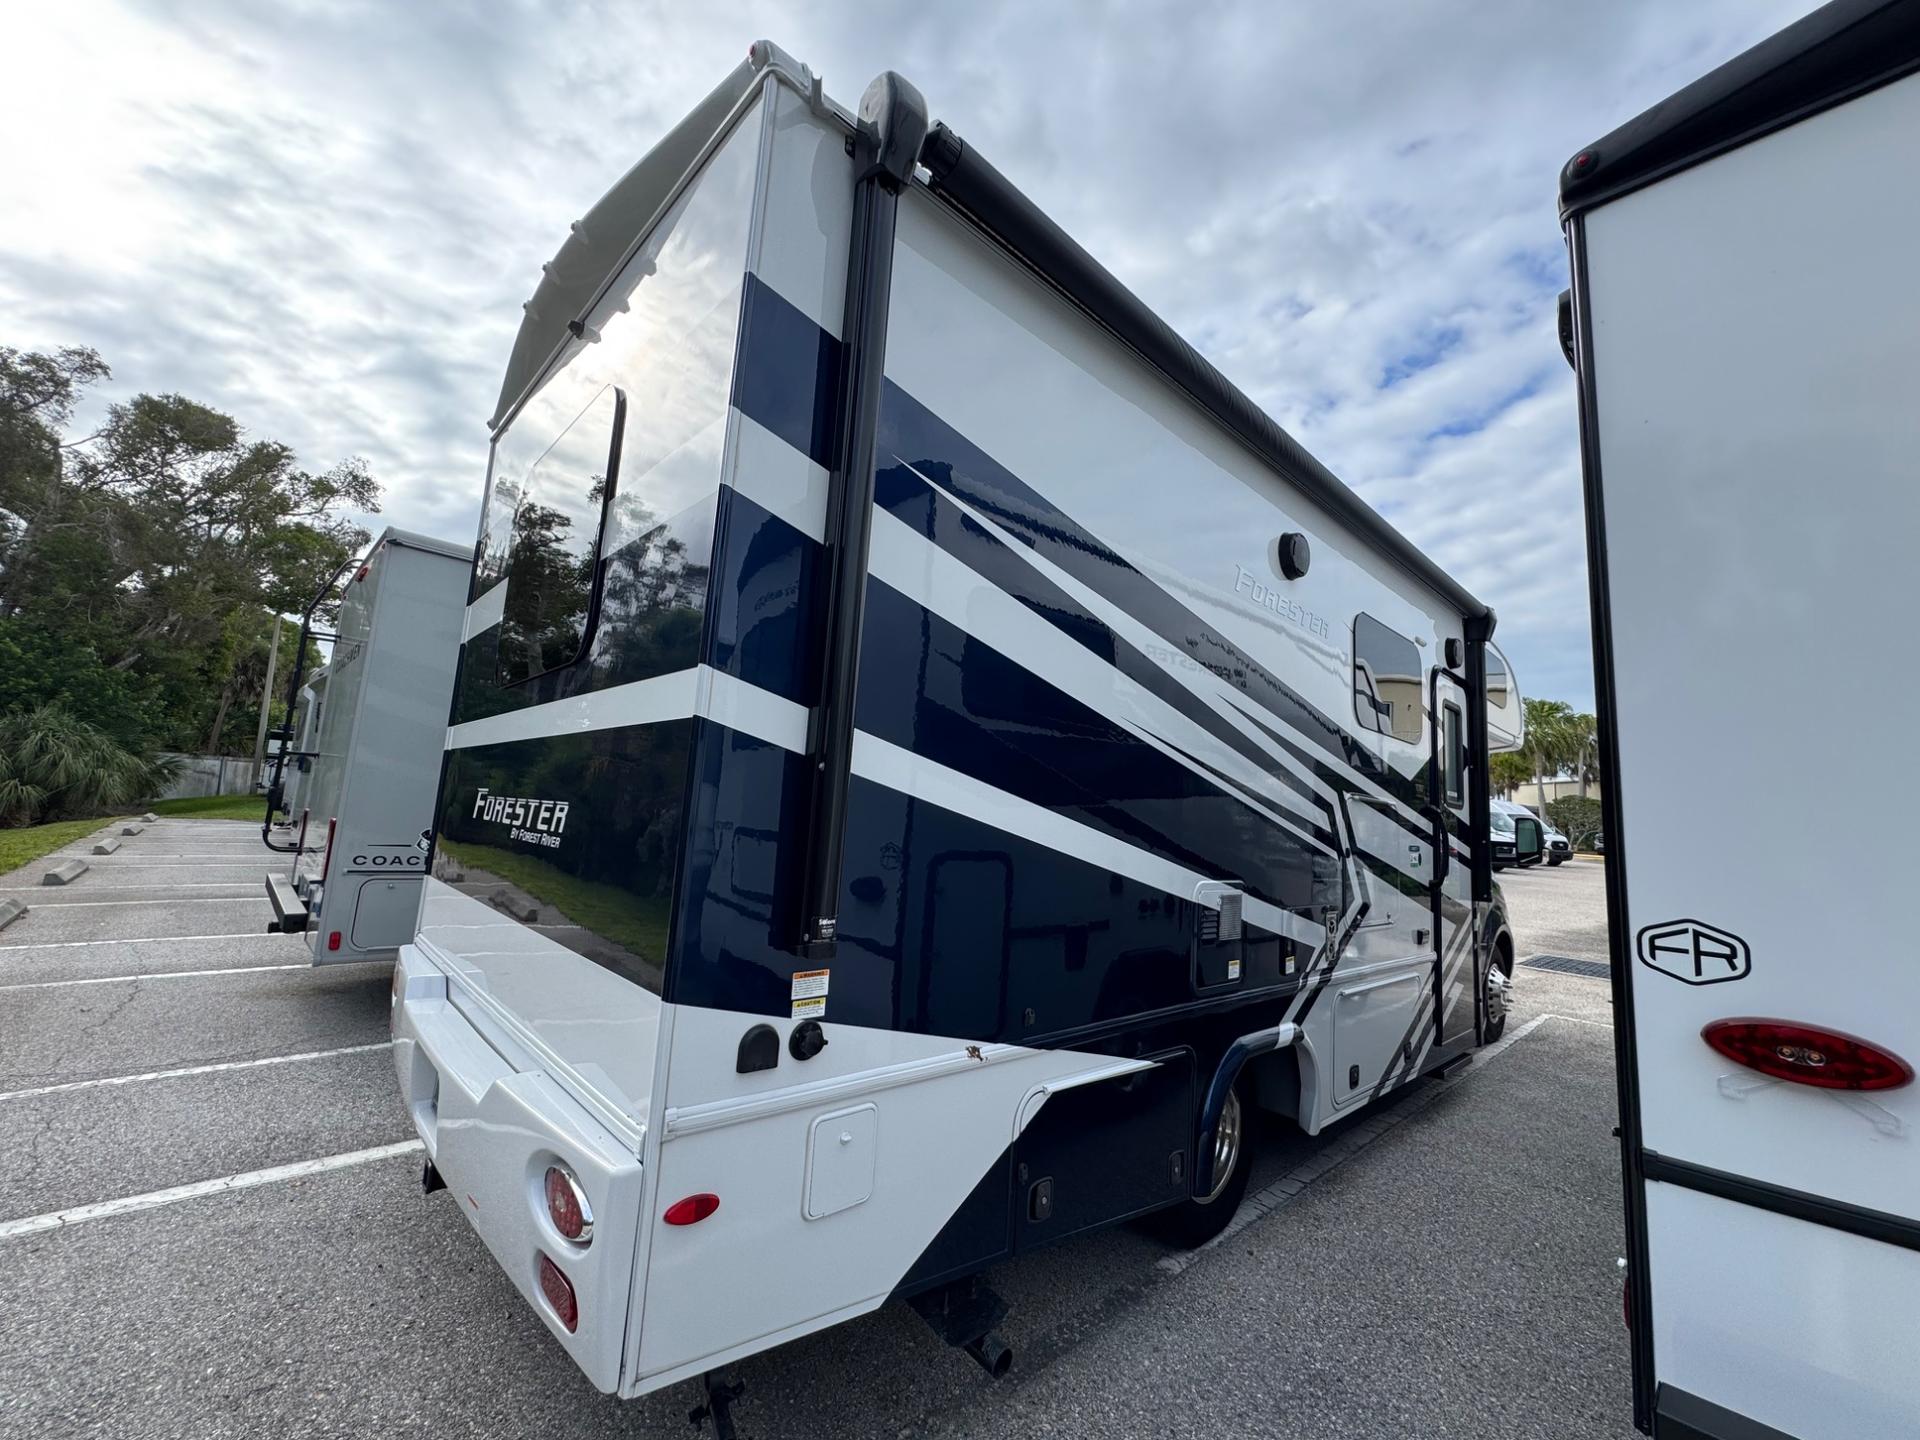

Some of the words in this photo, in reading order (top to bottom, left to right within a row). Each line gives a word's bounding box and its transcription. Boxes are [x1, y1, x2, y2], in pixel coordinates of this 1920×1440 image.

[1234, 564, 1329, 640] FORESTER
[472, 787, 569, 833] FORESTER
[352, 855, 427, 866] COAC
[518, 829, 542, 845] FOREST
[540, 832, 561, 849] RIVER
[1648, 927, 1739, 978] FR
